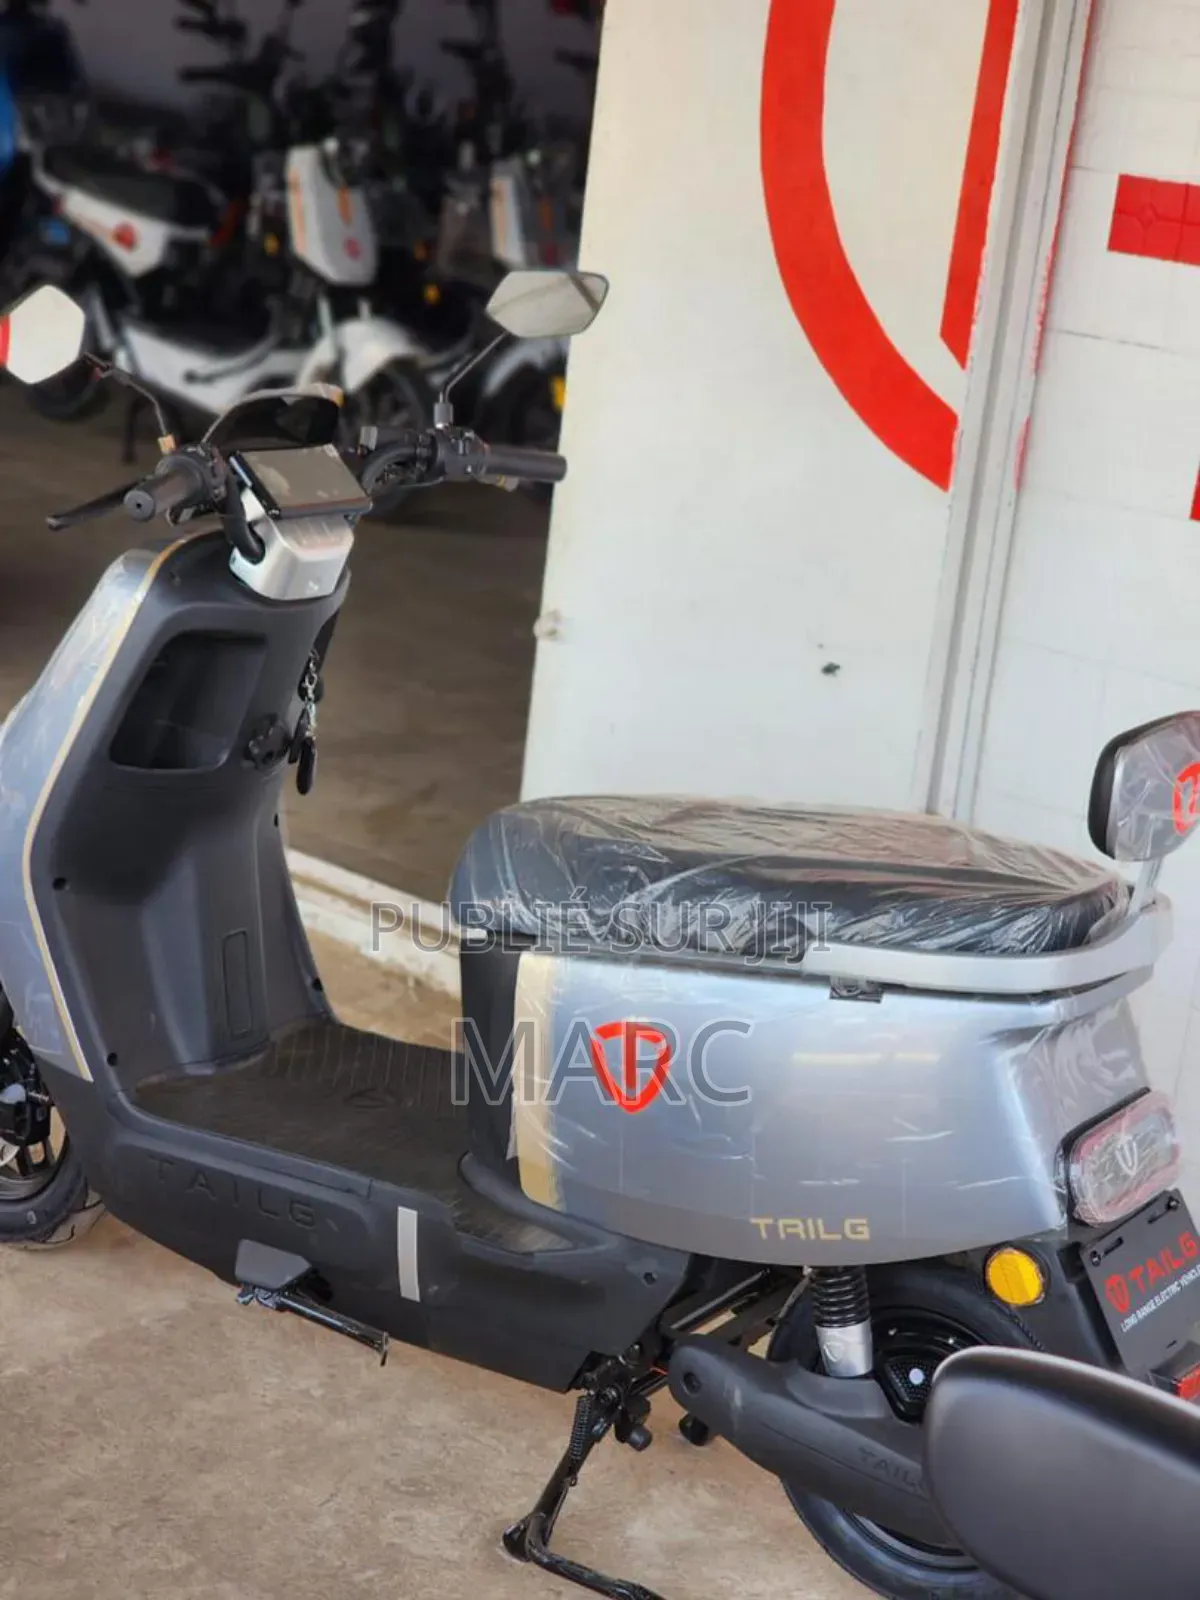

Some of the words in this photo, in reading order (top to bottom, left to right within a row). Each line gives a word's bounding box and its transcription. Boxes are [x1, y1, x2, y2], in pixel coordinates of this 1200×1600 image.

[148, 1154, 317, 1230] TAILG
[749, 1217, 870, 1241] TAILG
[1127, 1231, 1198, 1297] TAILG
